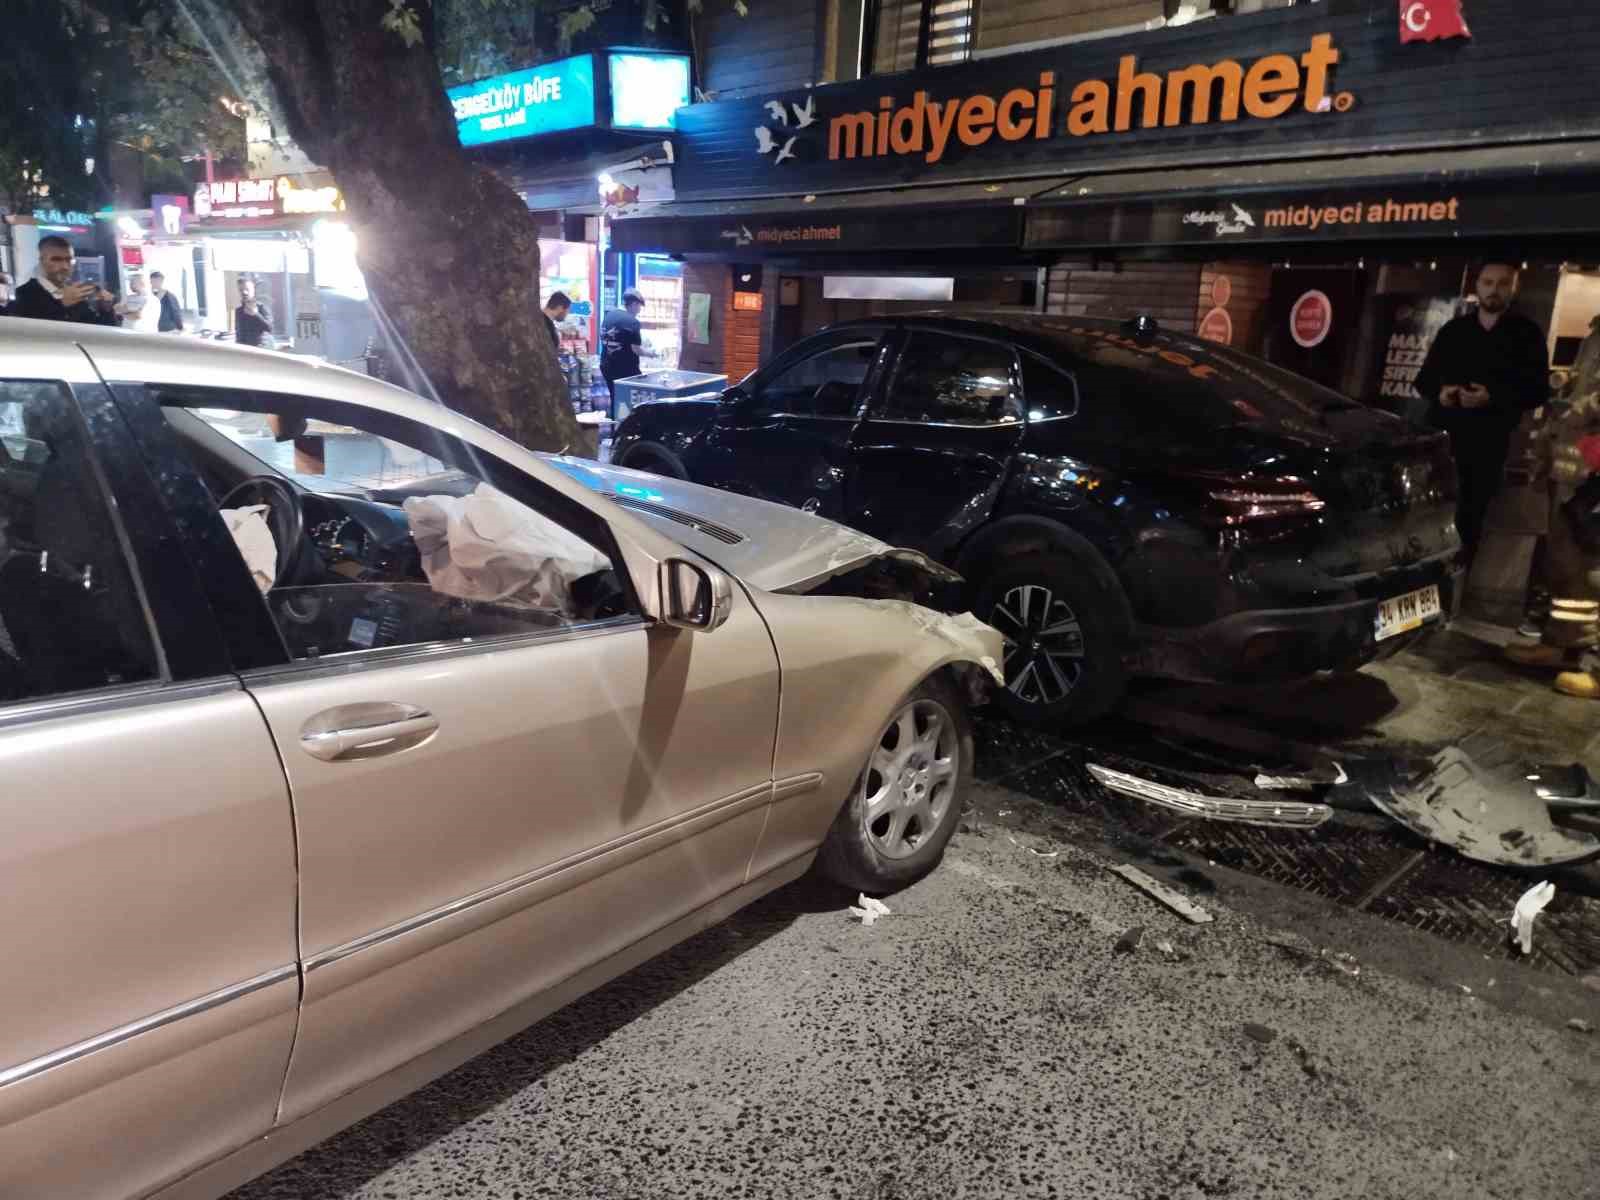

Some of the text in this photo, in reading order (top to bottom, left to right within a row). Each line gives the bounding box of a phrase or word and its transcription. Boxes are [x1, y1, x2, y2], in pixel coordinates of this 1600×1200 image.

[523, 75, 562, 106] BÜFE
[828, 32, 1339, 164] midyeci ahmet
[1264, 201, 1361, 230] midyeci
[1367, 197, 1458, 223] ahmet
[757, 226, 801, 244] midyeci
[802, 225, 840, 240] ahmet
